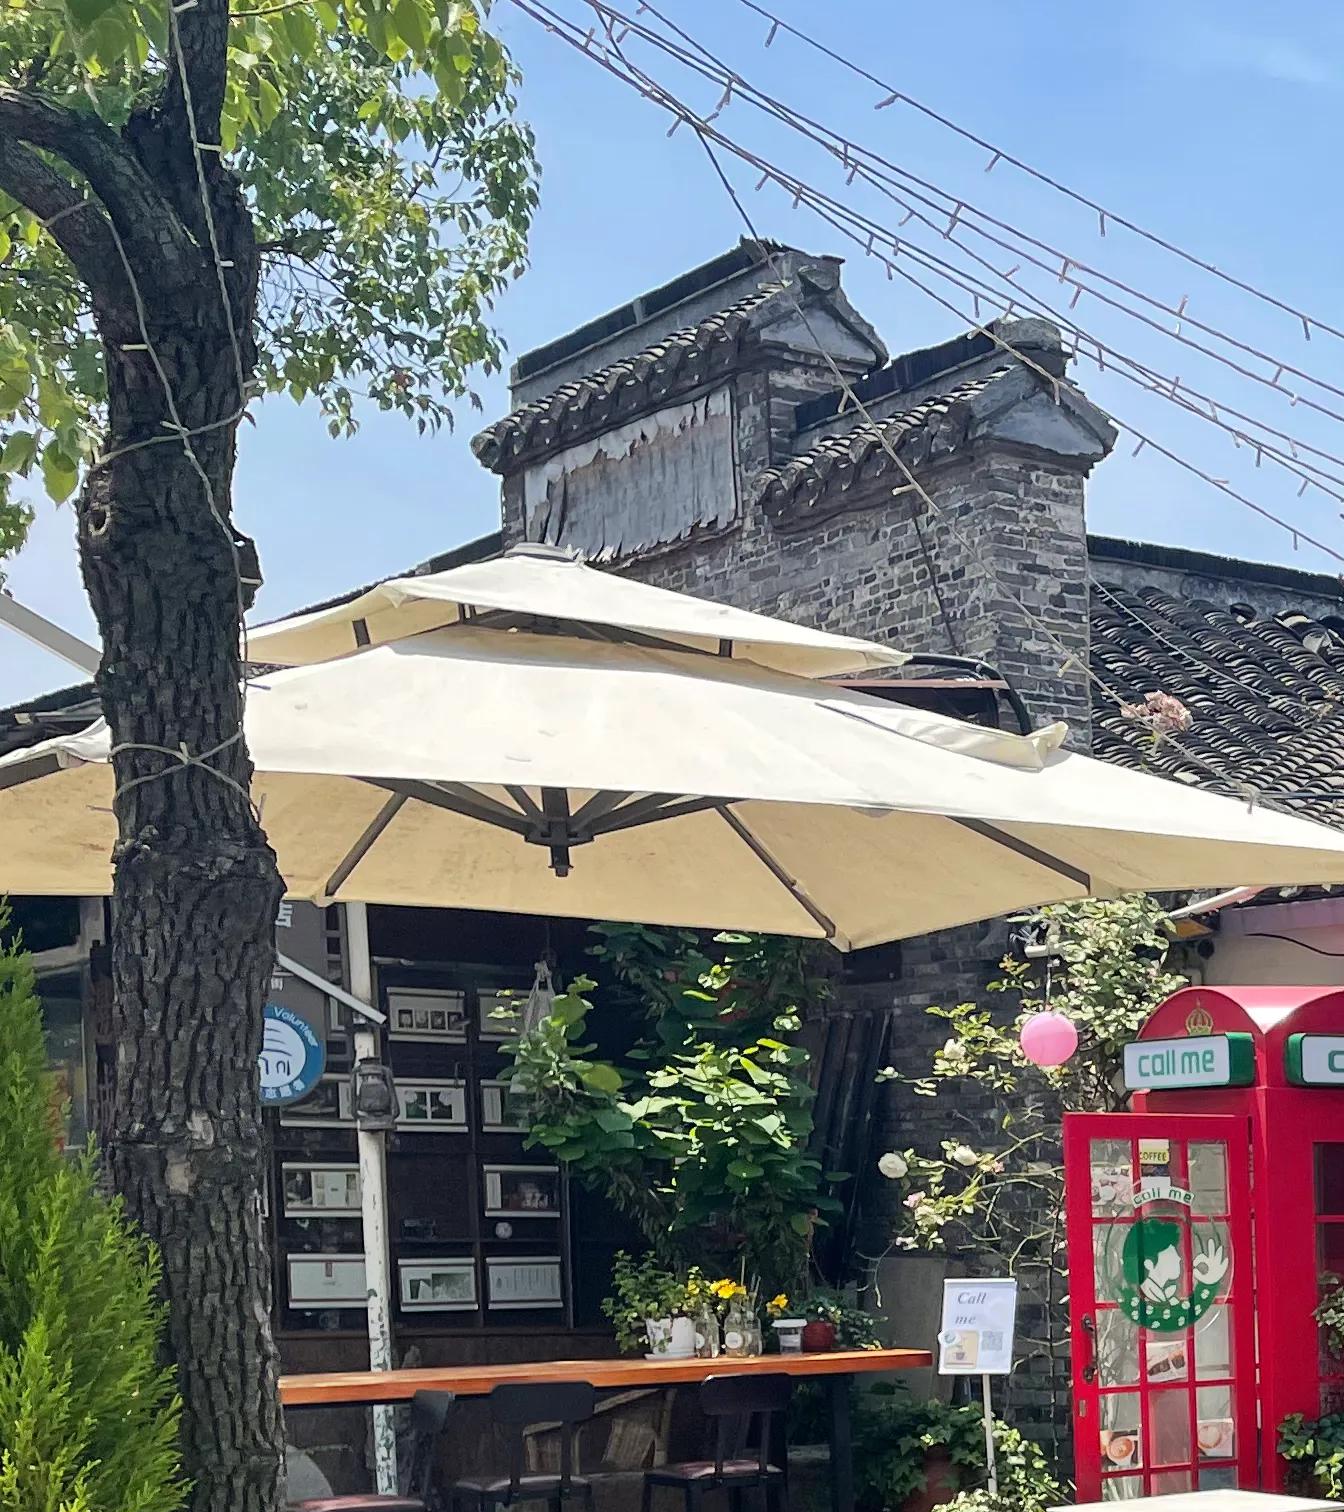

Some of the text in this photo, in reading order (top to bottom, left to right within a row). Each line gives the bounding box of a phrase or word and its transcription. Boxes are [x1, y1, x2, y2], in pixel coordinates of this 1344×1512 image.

[1138, 1049, 1215, 1077] call me
[1169, 1189, 1192, 1203] me
[957, 1292, 987, 1305] Call
[954, 1316, 976, 1325] me
